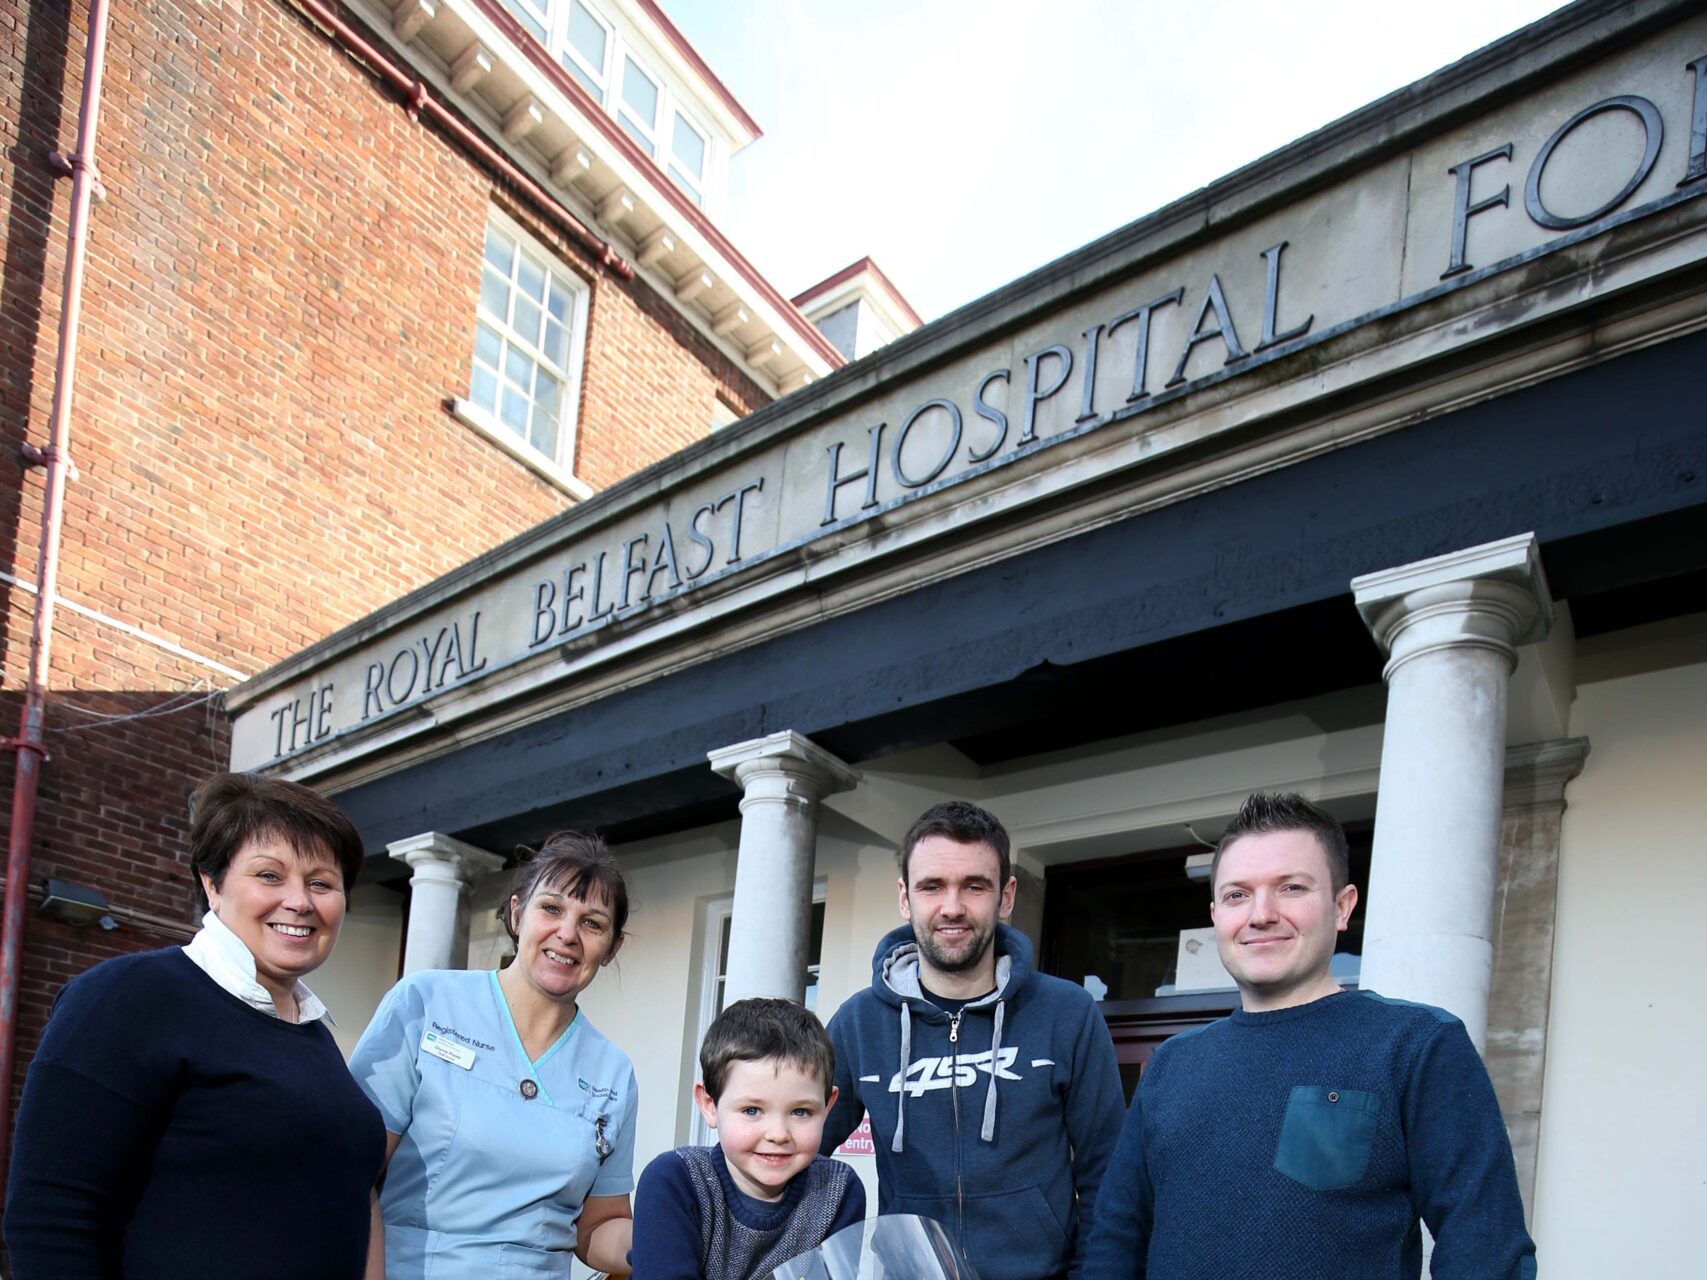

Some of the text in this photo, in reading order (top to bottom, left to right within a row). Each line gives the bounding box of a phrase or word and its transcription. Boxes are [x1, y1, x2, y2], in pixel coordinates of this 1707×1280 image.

[271, 682, 334, 759] THE
[362, 610, 487, 719] ROYAL
[529, 477, 763, 648] BELFAST
[819, 240, 1315, 527] HOSPITAL
[431, 1021, 471, 1044] Registered
[471, 1039, 496, 1052] Nurse
